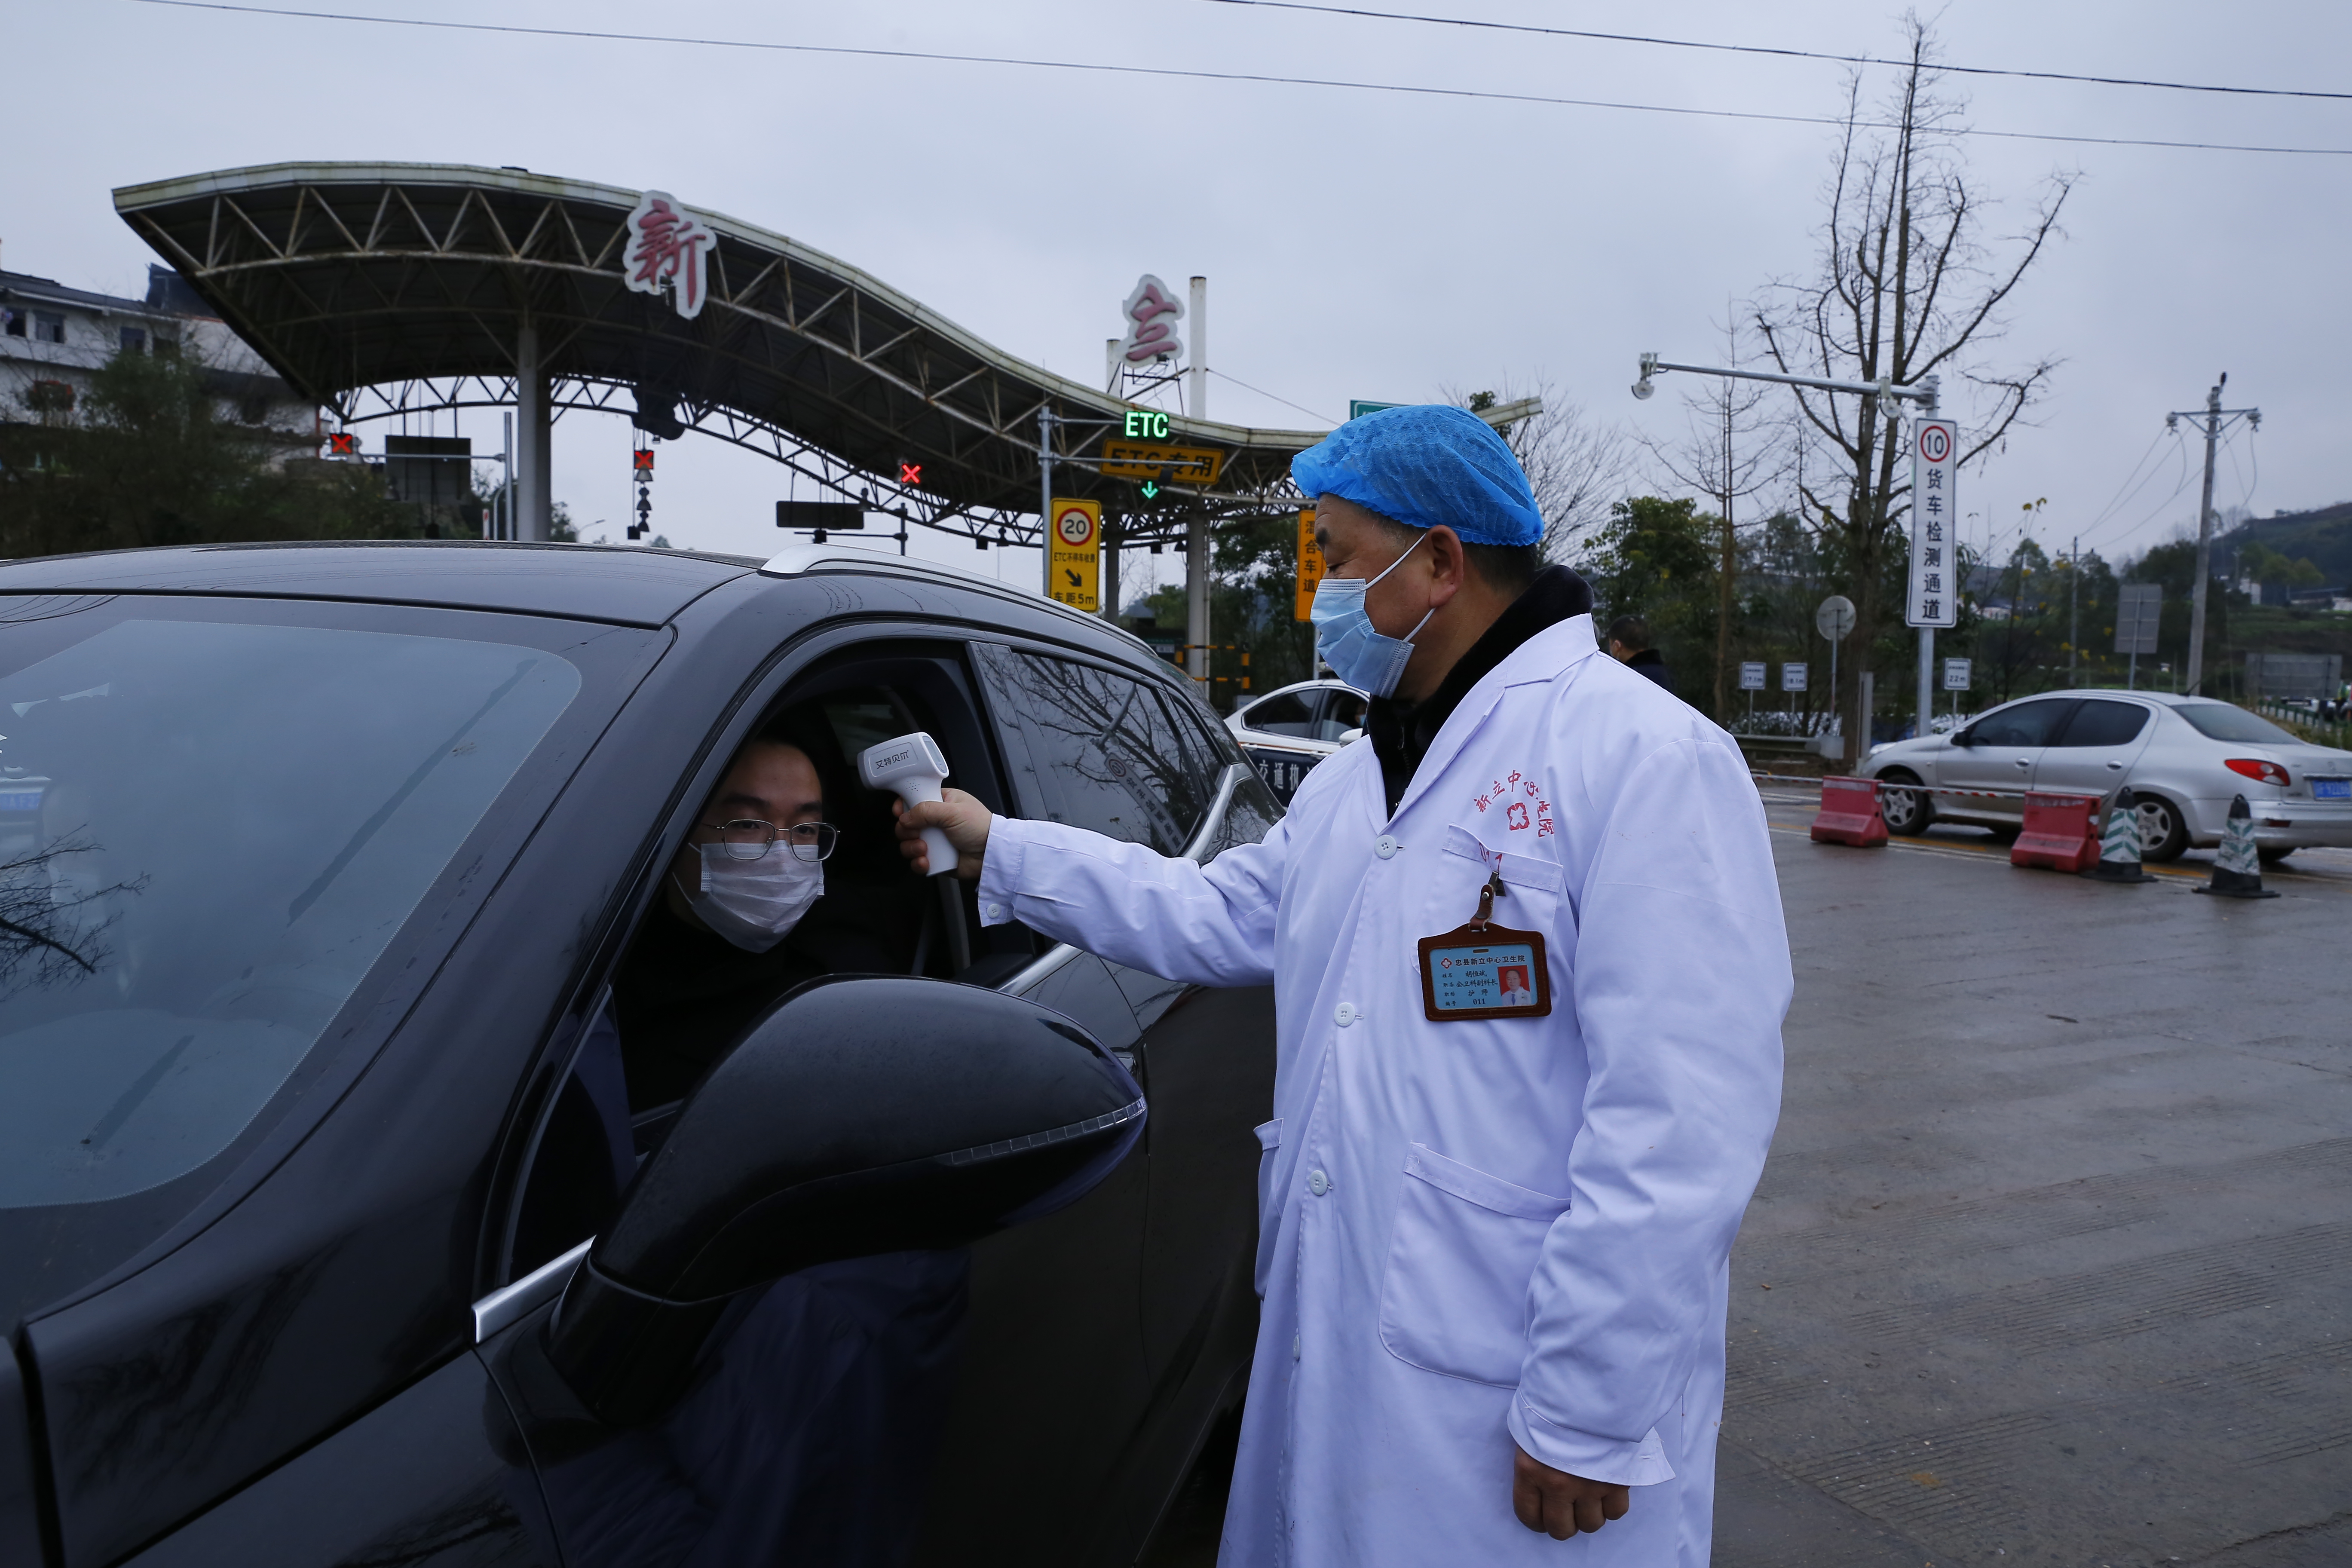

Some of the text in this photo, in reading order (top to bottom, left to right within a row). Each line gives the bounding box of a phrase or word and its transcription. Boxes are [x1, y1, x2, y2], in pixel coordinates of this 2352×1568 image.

[633, 199, 706, 309] 新
[1125, 411, 1169, 438] ETC
[1927, 435, 1944, 454] 10
[1110, 448, 1214, 477] ETC专用
[1064, 519, 1086, 534] 20
[1303, 520, 1320, 592] 混合车道
[1922, 469, 1942, 619] 货车检测通道
[1259, 759, 1311, 792] 交通执
[1455, 955, 1525, 966] 忠县新立中心卫生院
